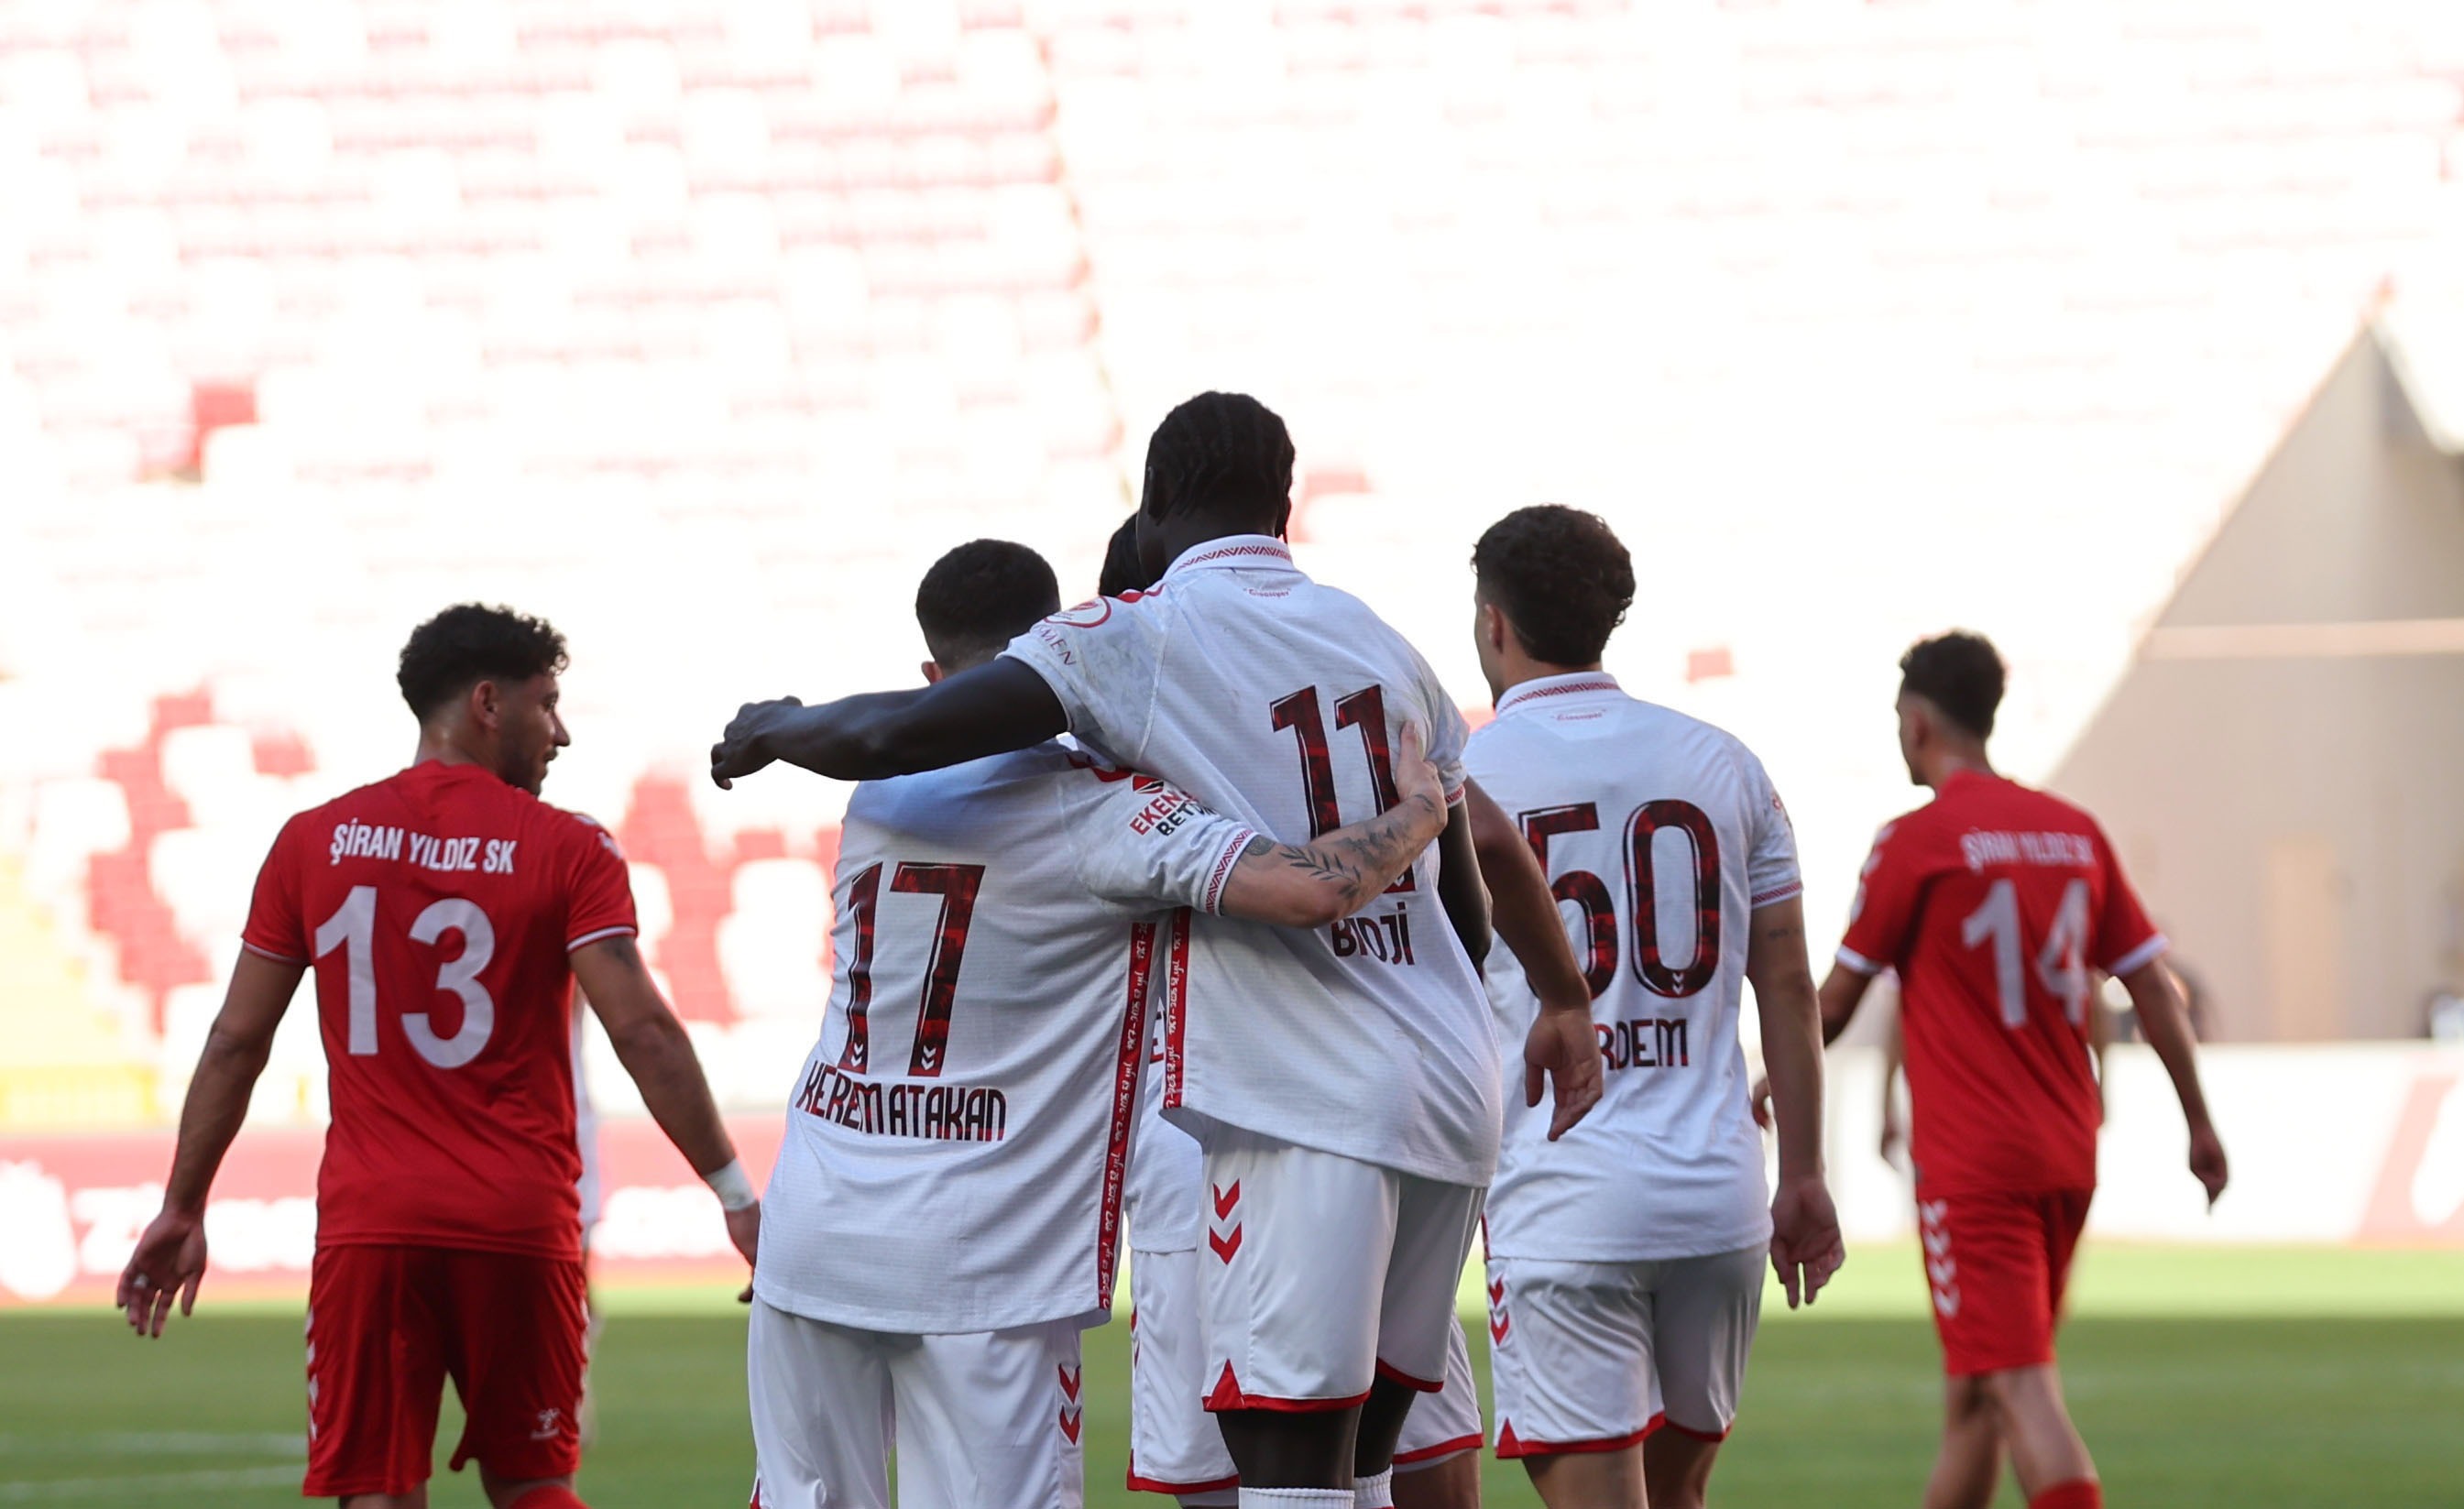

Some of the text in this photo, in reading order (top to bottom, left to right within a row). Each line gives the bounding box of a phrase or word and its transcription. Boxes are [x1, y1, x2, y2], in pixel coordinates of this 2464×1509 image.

[1037, 626, 1078, 666] MEN
[329, 817, 518, 873] ŞİRAN YILDIZ SK
[1269, 683, 1417, 894] 11
[314, 884, 496, 1069] 13
[837, 860, 987, 1078] 17
[1517, 798, 1721, 999] 50
[1962, 878, 2091, 1029] 14
[1593, 1017, 1689, 1070] RDEM
